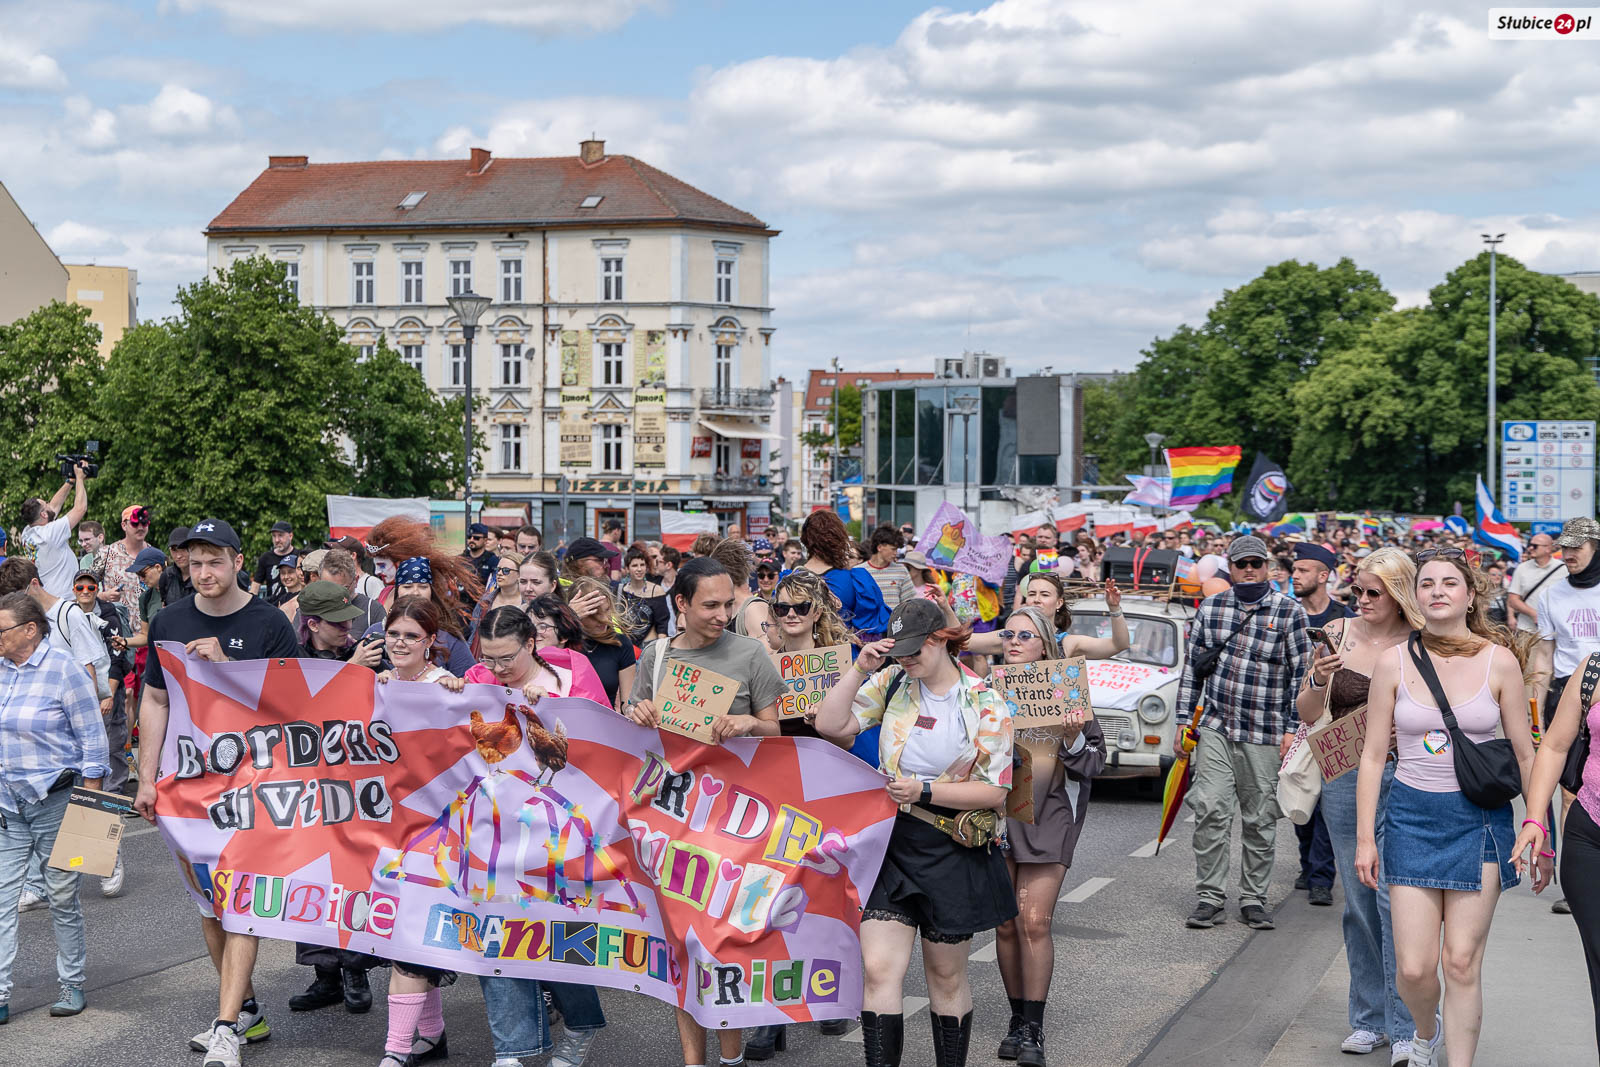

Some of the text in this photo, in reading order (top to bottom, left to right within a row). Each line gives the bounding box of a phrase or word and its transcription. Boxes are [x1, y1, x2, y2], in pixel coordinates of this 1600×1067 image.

[1513, 427, 1529, 438] PL
[1571, 622, 1598, 637] TEAM
[781, 651, 839, 678] PRIDE
[672, 664, 701, 683] LIEB
[1004, 667, 1050, 689] protect
[677, 690, 707, 707] WEN
[1016, 686, 1053, 701] trans
[663, 701, 681, 714] DU
[1025, 703, 1062, 718] lives
[661, 714, 701, 732] WILLST
[1316, 722, 1353, 755] WERE
[1319, 745, 1356, 779] WERE
